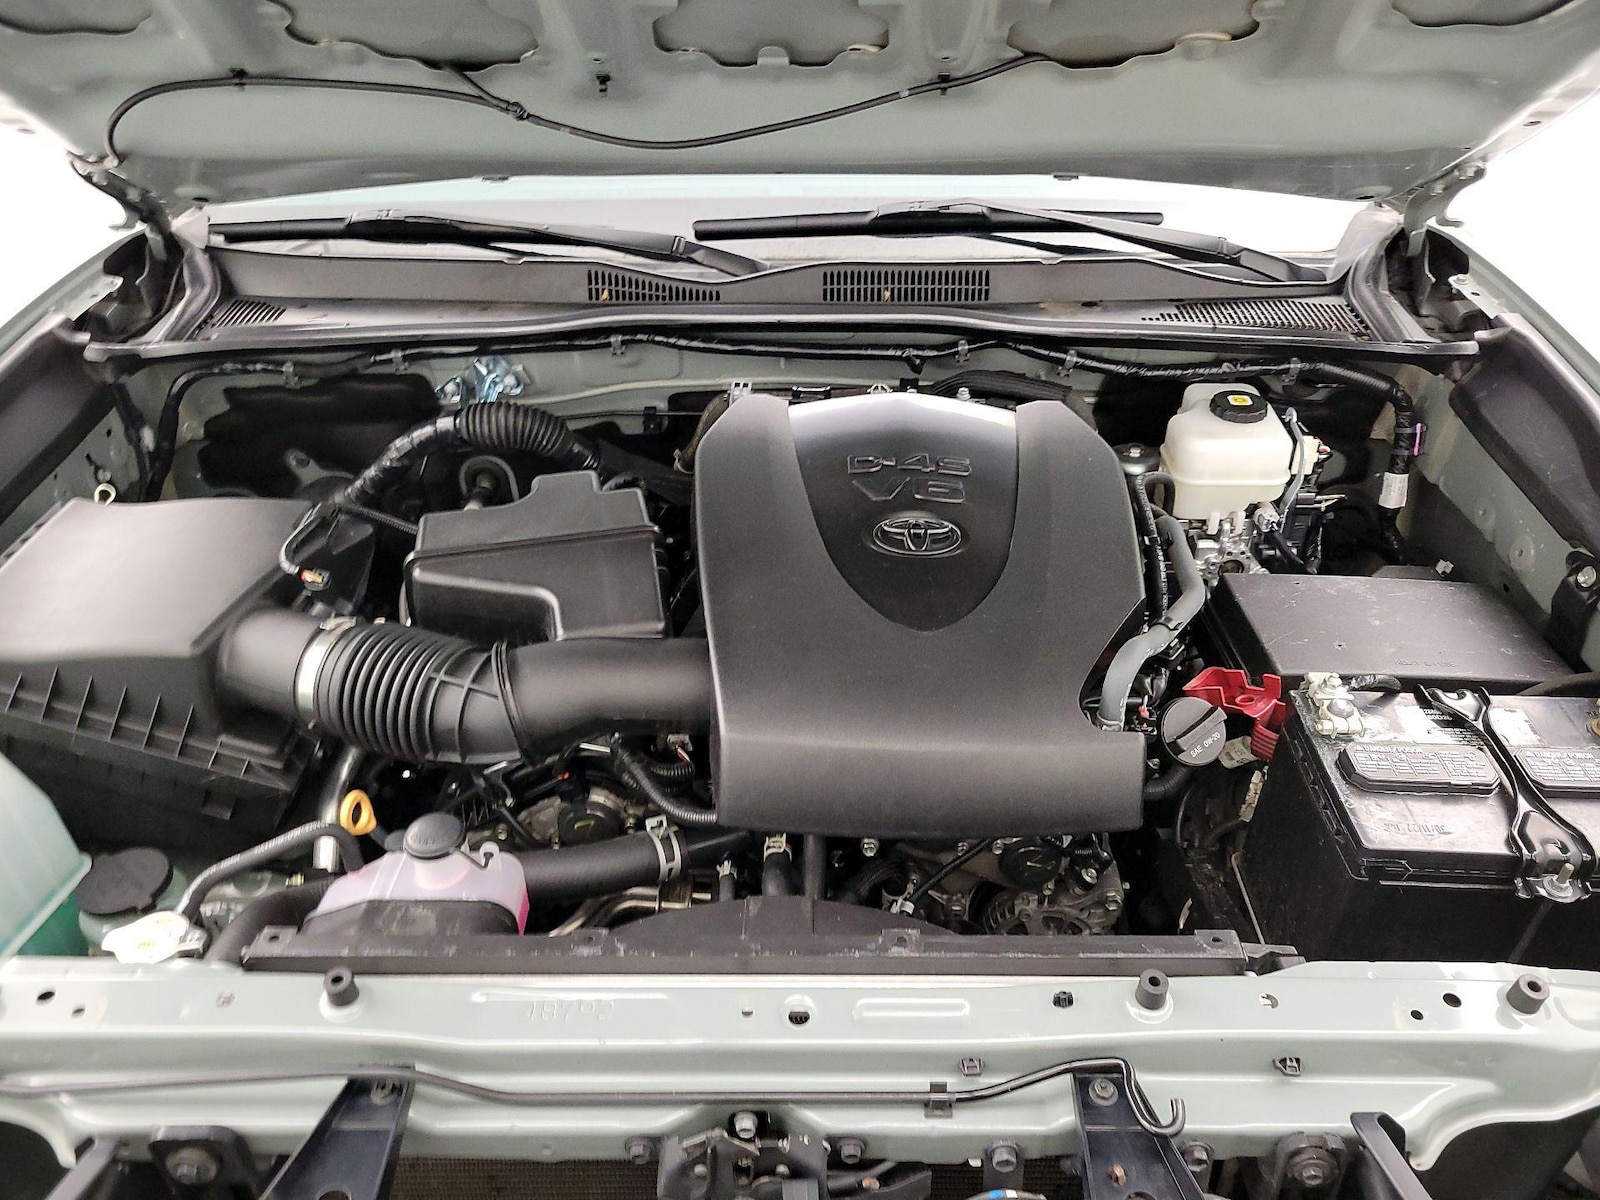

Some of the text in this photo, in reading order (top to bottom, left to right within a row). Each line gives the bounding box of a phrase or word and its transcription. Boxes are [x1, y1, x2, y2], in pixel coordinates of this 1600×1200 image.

[847, 453, 972, 476] D-4S
[852, 476, 966, 503] V6
[1190, 731, 1221, 758] SAE 0W-20
